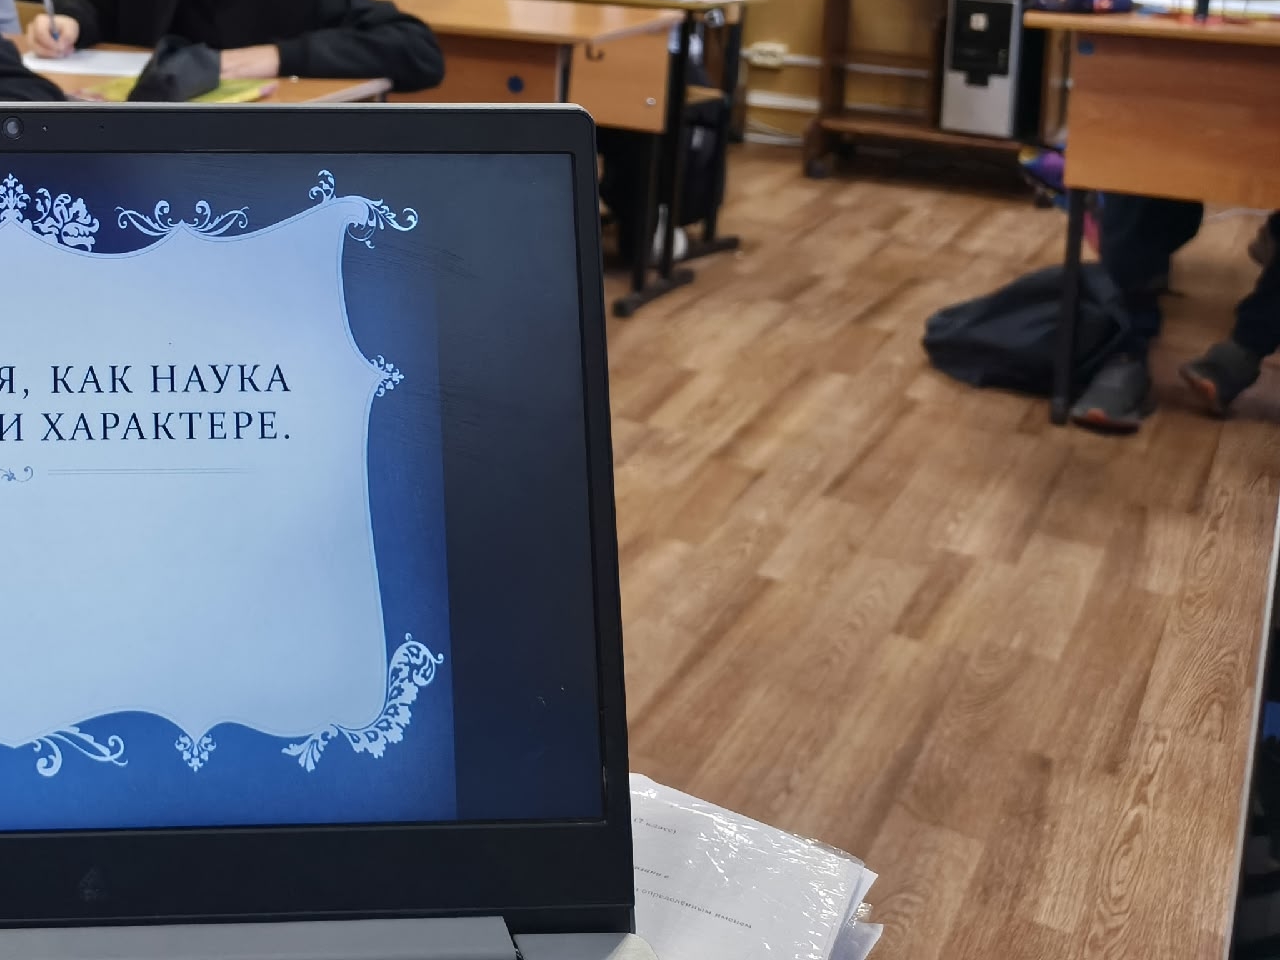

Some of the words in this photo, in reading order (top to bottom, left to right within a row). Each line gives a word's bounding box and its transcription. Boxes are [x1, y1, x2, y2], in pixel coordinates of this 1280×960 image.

[50, 364, 134, 394] КАК
[150, 363, 291, 394] НАУКА
[40, 411, 291, 442] ХАРАКТЕРЕ.
